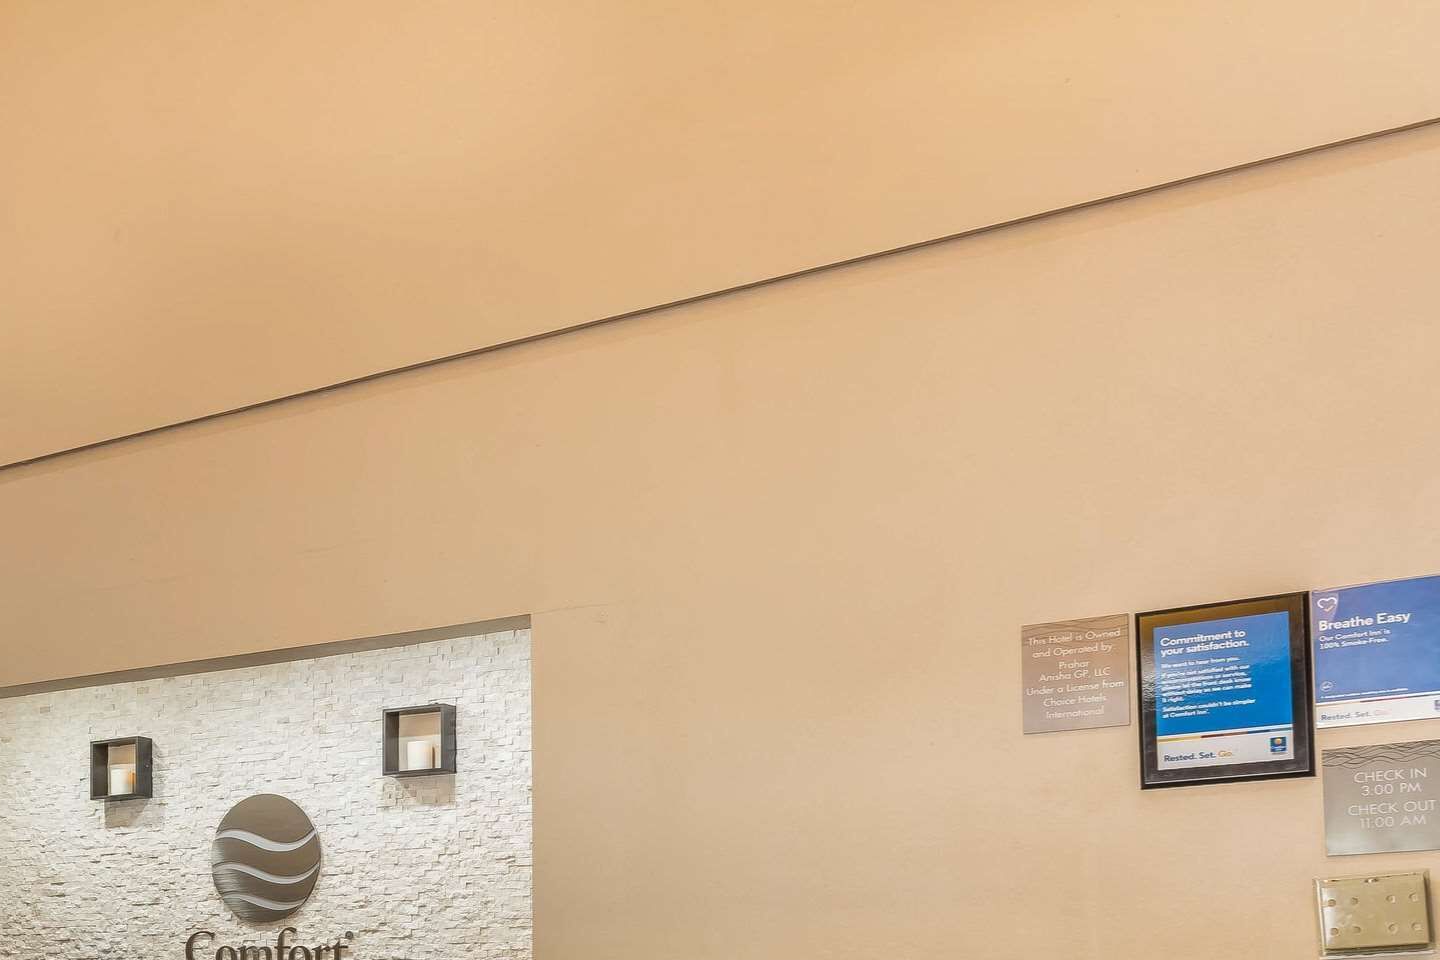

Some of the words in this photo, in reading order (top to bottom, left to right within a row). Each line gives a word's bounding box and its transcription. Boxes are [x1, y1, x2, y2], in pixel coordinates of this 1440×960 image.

[1319, 616, 1373, 631] Breathe
[1377, 613, 1410, 624] Easy
[1028, 638, 1046, 646] This
[1049, 633, 1073, 644] Hotel
[1085, 629, 1120, 640] Owned
[1160, 632, 1232, 647] Commitment
[1234, 630, 1246, 638] to
[1032, 648, 1050, 658] and
[1054, 643, 1098, 656] Operated
[1101, 642, 1113, 653] by
[1160, 648, 1184, 658] your
[1186, 639, 1250, 653] satisfaction.
[1094, 666, 1111, 676] LLC
[1026, 687, 1055, 696] Under
[1067, 683, 1099, 692] License
[1102, 679, 1124, 688] from
[1043, 697, 1075, 707] Choice
[1078, 693, 1106, 703] Hotels
[1046, 706, 1104, 719] International
[1170, 710, 1196, 718] Comfort
[1164, 753, 1197, 761] Rested.
[1353, 769, 1405, 783] CHECK
[1410, 768, 1428, 779] IN
[1361, 784, 1394, 796] 3:00
[1400, 783, 1423, 793] PM
[1348, 803, 1399, 816] CHECK
[1403, 800, 1437, 812] OUT
[1360, 817, 1394, 829] 11:00
[1400, 815, 1427, 826] AM
